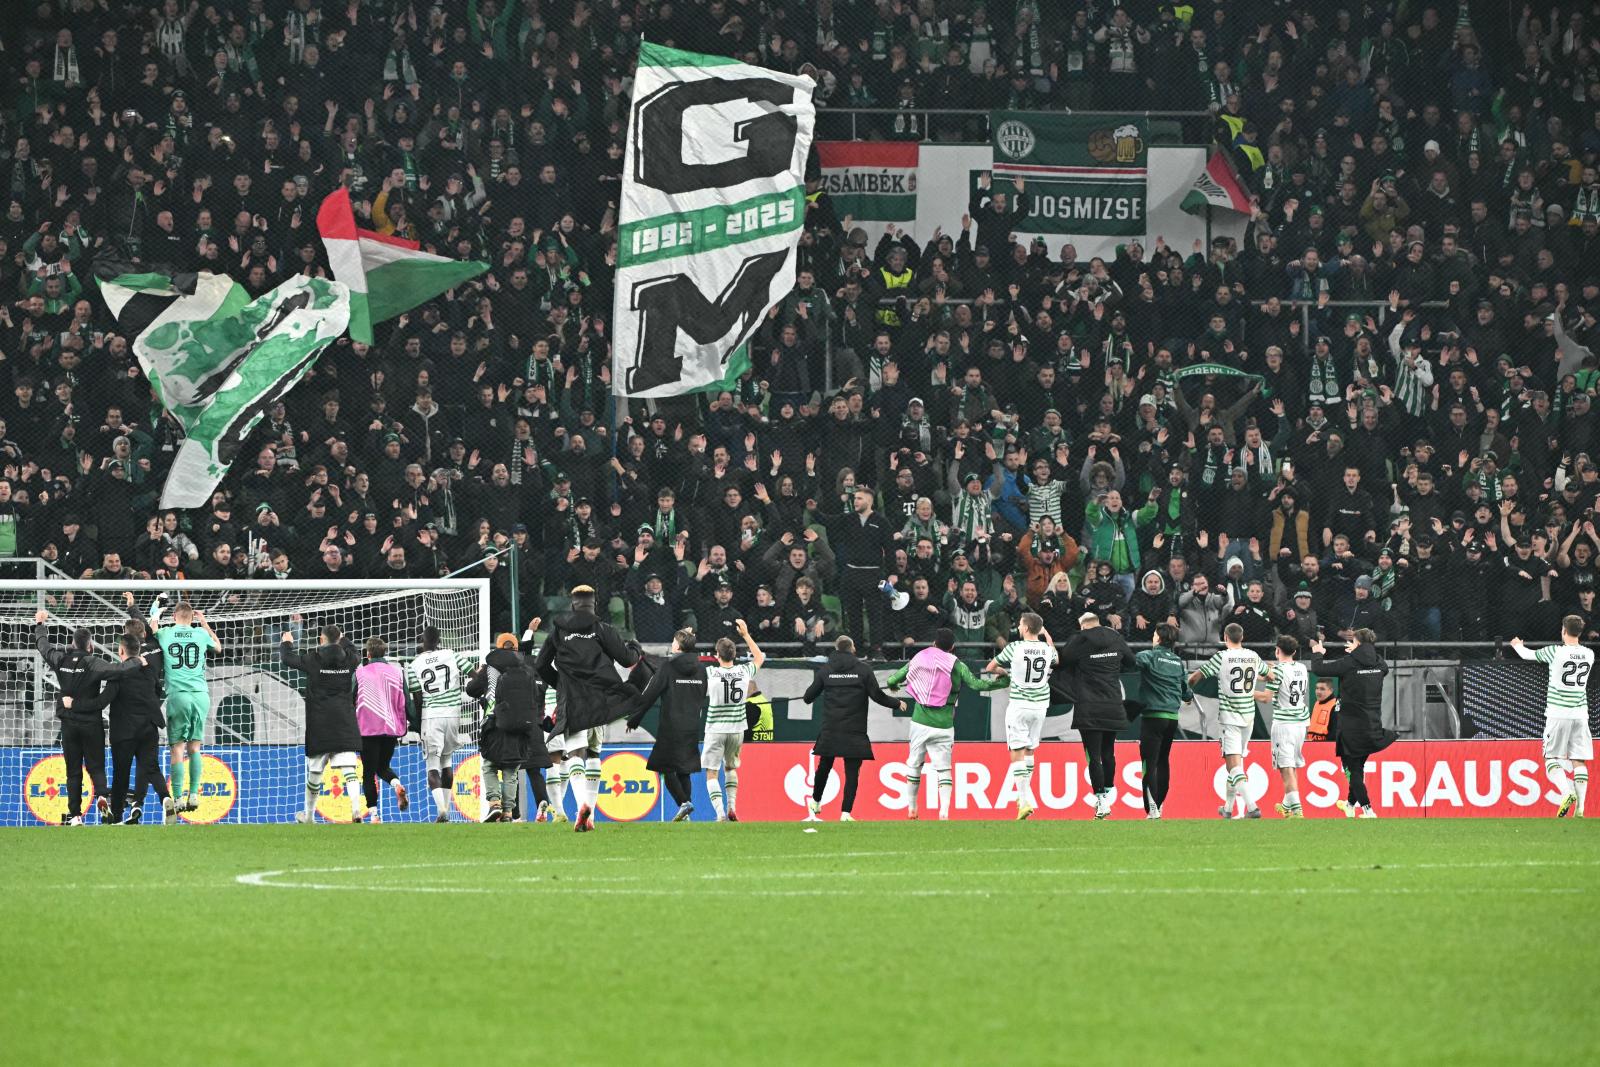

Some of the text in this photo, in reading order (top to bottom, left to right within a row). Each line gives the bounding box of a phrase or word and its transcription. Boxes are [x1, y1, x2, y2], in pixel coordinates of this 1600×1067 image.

[634, 77, 797, 195] G
[817, 169, 905, 193] ZSÁMBÉK
[632, 221, 692, 255] 1995
[725, 198, 795, 236] 2025
[626, 246, 790, 395] M
[168, 642, 200, 670] 90
[1023, 656, 1047, 684] 19
[420, 663, 450, 694] 27
[1230, 666, 1255, 694] 28
[1562, 660, 1591, 687] 22
[721, 677, 744, 704] 16
